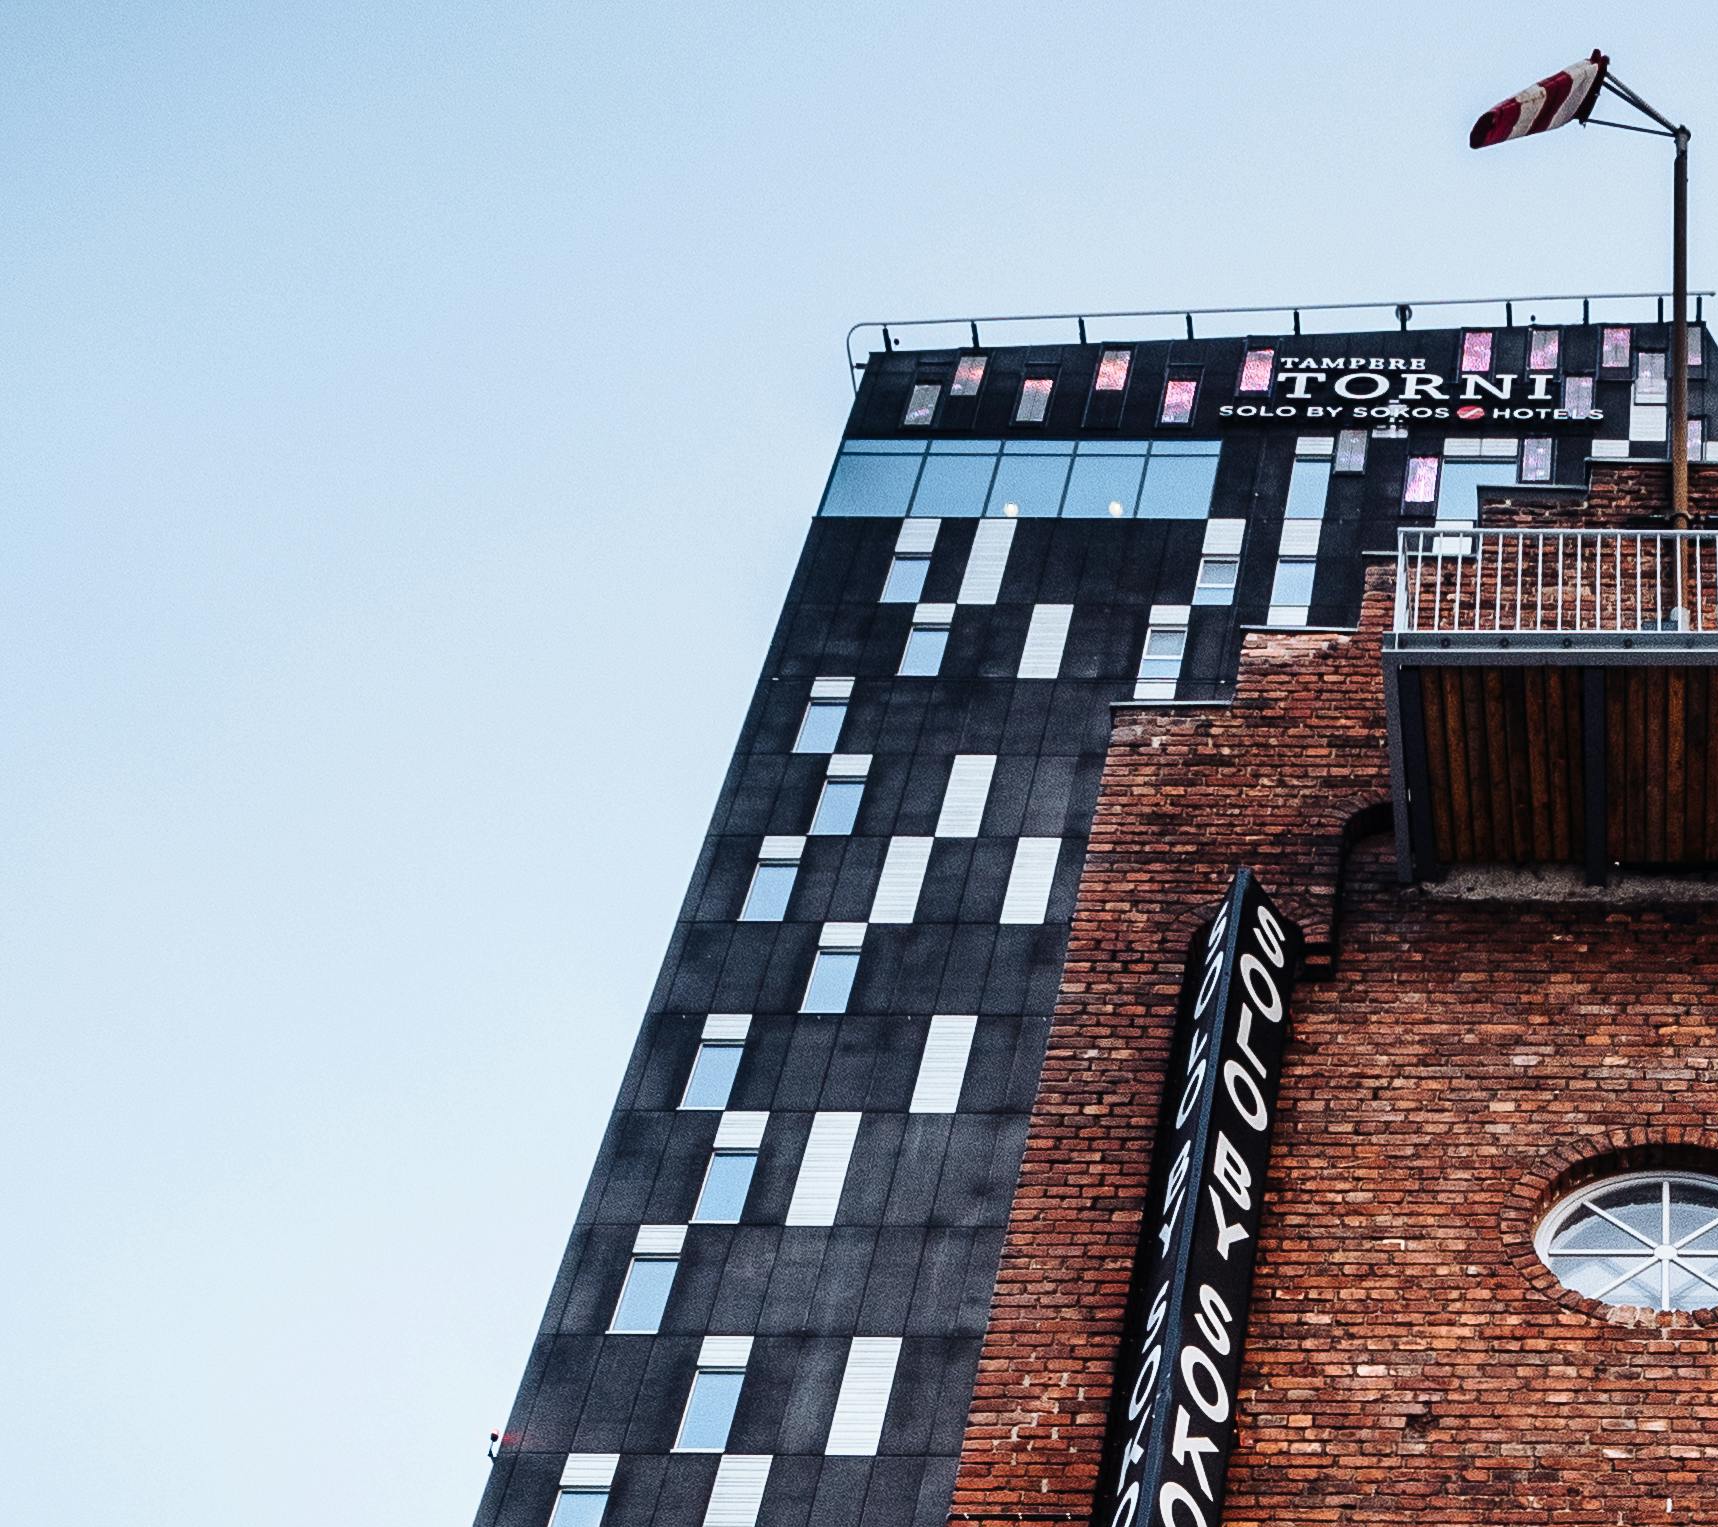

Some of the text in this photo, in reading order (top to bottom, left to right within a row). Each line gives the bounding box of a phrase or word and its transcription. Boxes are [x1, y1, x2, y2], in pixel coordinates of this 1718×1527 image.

[1219, 405, 1604, 420] SOLO BY SOKOS HOTELS
[1277, 372, 1553, 400] TORNI
[1280, 357, 1426, 370] TAMPERE
[1176, 901, 1229, 1131] SOLO
[1223, 904, 1287, 1133] SOLO
[1159, 1139, 1191, 1258] BY
[1208, 1130, 1253, 1262] BY
